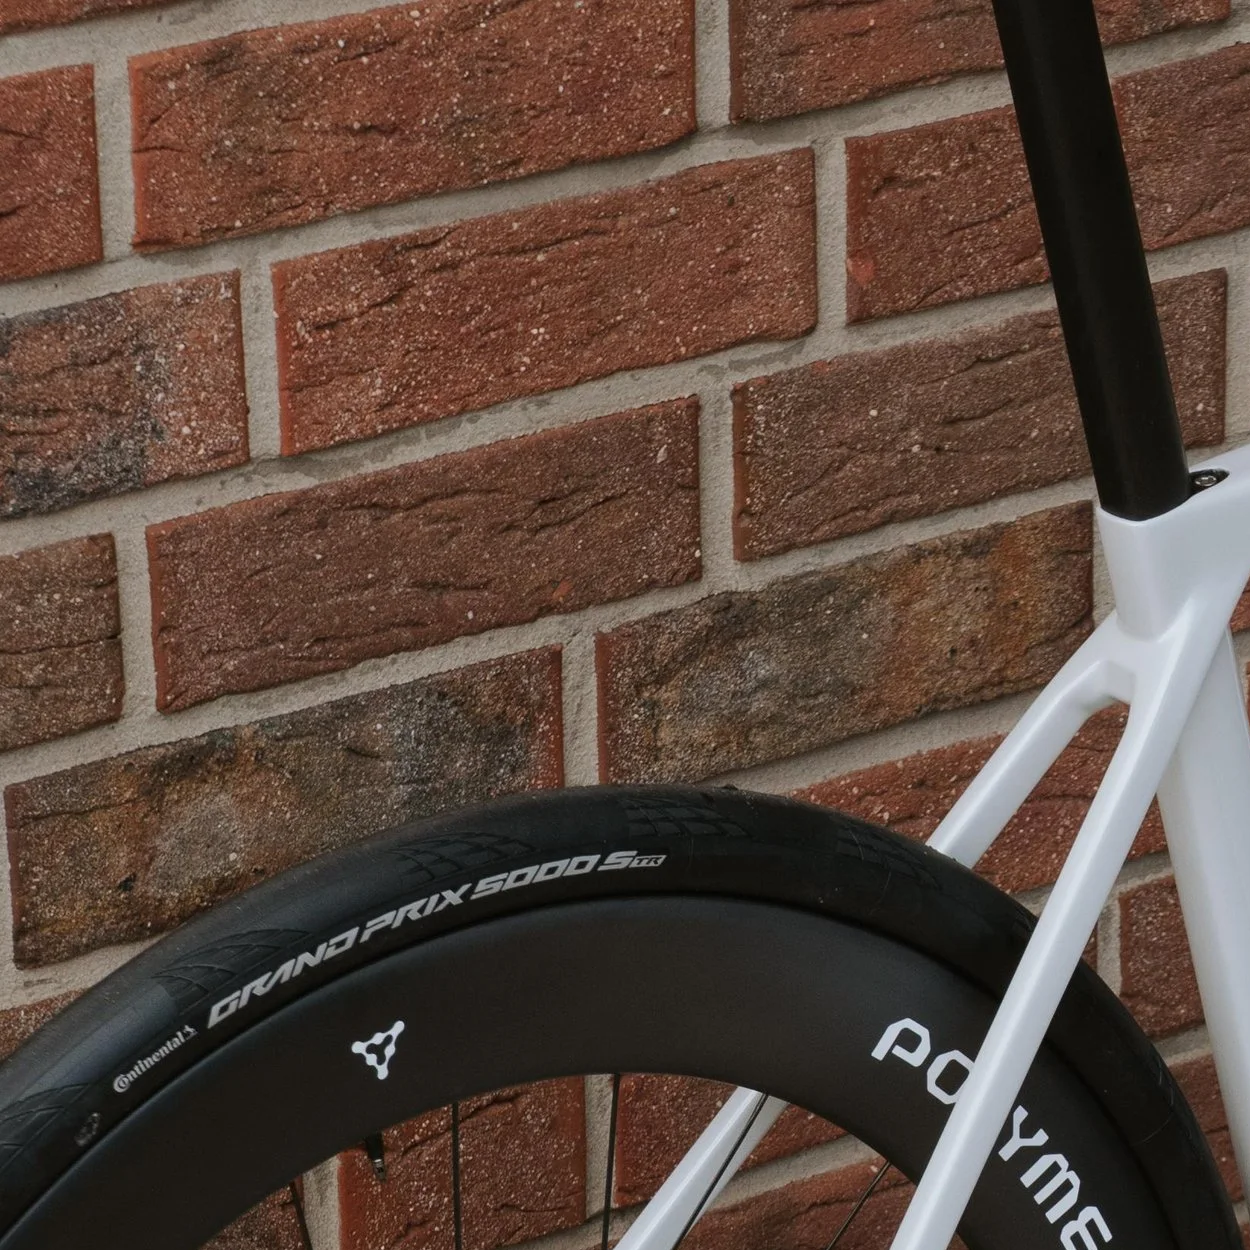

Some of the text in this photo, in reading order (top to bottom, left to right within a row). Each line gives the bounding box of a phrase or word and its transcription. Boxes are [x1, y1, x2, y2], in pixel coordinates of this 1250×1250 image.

[207, 926, 360, 1029] GRAND
[360, 883, 472, 943] PRIX
[470, 854, 601, 900] 5000
[113, 1031, 187, 1093] Continental
